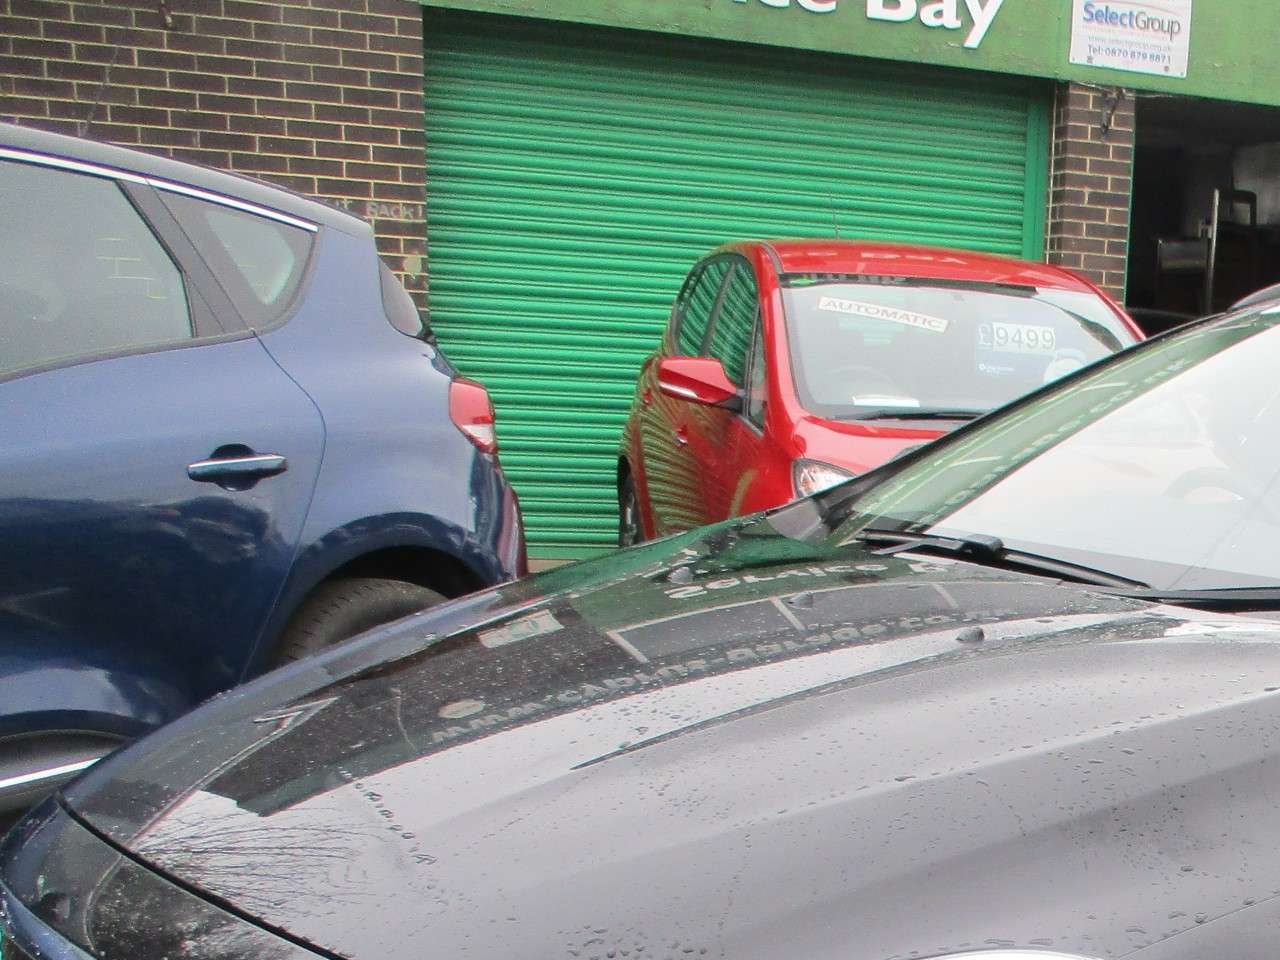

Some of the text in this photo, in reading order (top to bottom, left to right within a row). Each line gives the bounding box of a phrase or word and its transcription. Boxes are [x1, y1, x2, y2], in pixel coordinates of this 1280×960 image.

[1082, 2, 1181, 40] SelectGroup
[823, 298, 943, 330] AUTOMATIC
[978, 322, 1056, 351] £9499
